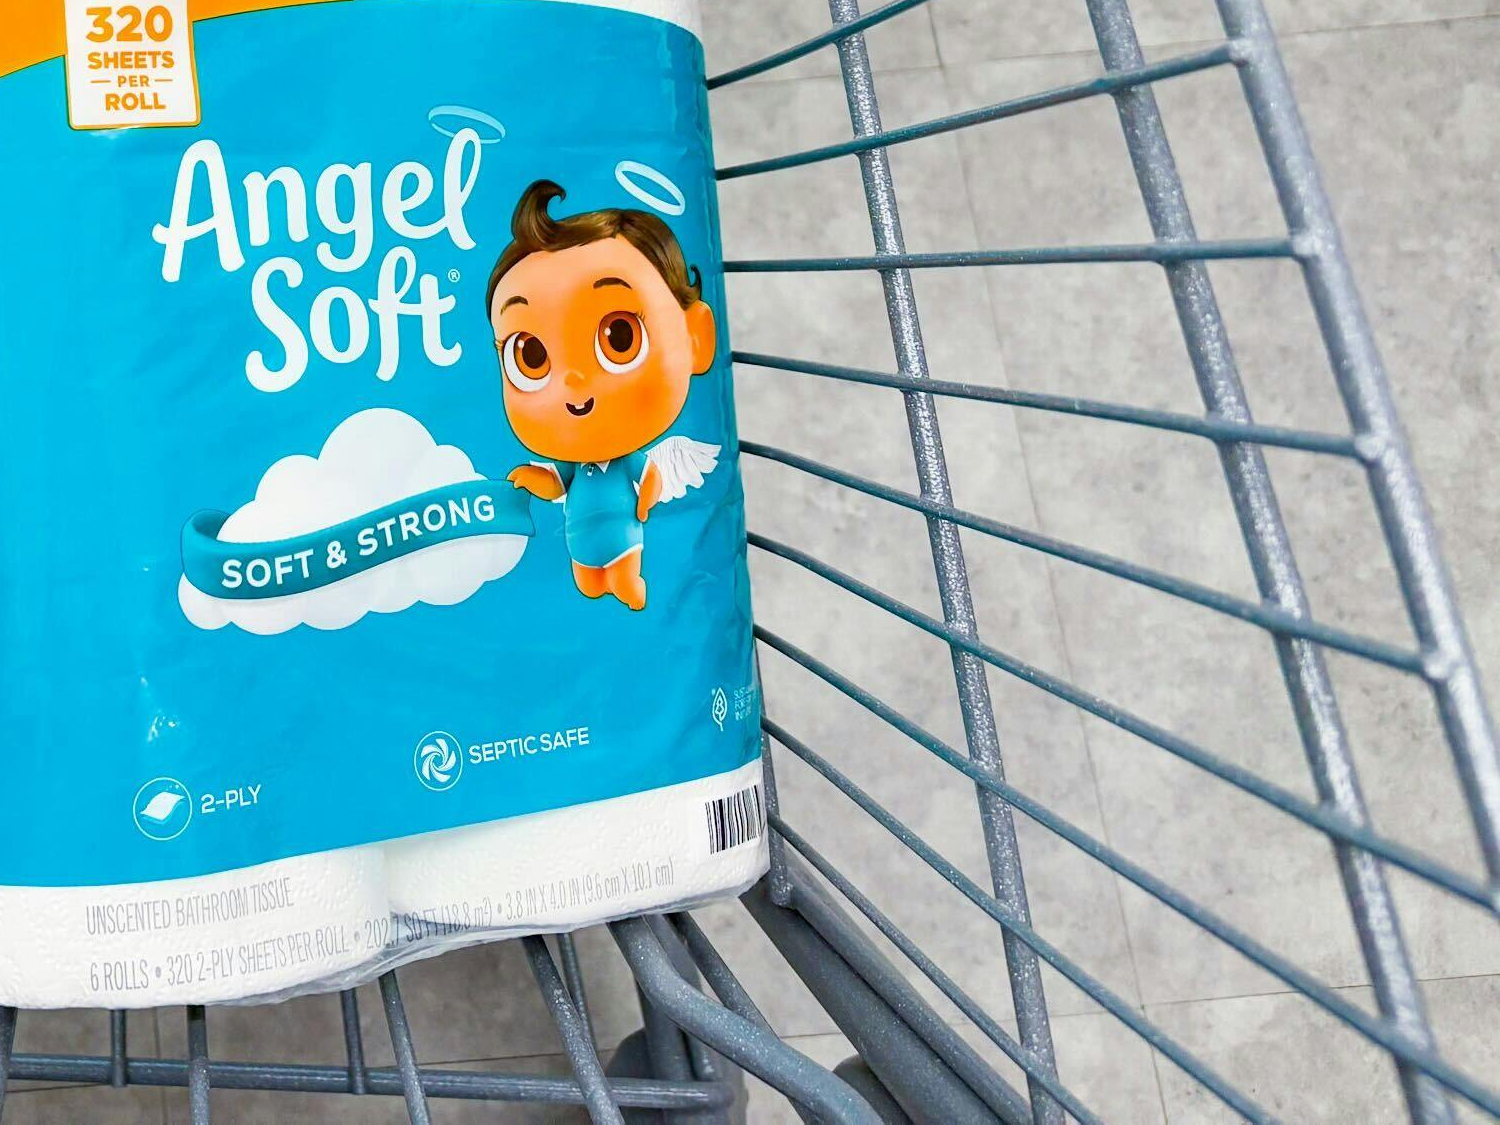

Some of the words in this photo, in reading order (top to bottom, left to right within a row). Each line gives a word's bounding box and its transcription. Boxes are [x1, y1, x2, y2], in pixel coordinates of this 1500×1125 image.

[85, 5, 173, 43] 320
[87, 50, 175, 71] SHEETS
[117, 75, 151, 88] PER
[104, 92, 166, 112] ROLL
[152, 128, 482, 283] Angel
[221, 549, 314, 589] SOFT
[326, 540, 348, 568] &
[357, 495, 496, 556] STRONG
[468, 737, 537, 765] SEPTIC
[540, 726, 590, 755] SAFE
[200, 784, 262, 814] 2-PLY
[86, 899, 171, 935] UNSCENTED
[176, 888, 249, 927] BATHROOM
[250, 877, 294, 916] TISSUE
[90, 962, 99, 991] 6
[104, 959, 149, 991] ROLLS
[167, 953, 192, 986] 320
[196, 947, 239, 982] 2-PLY
[239, 937, 287, 975] SHEETS
[287, 931, 315, 965] PER
[315, 926, 350, 958] ROLL
[364, 914, 399, 949] 202.7
[406, 914, 422, 943] SQ
[423, 908, 438, 937] FT
[439, 901, 471, 937] (18.8
[505, 891, 523, 921] 3.8
[525, 887, 537, 917] IN
[549, 879, 567, 910] 4.0
[569, 877, 581, 907] IN
[581, 874, 603, 906] (9.6
[604, 875, 620, 900] cm
[632, 860, 653, 892] 10.1
[655, 856, 676, 887] cm)
